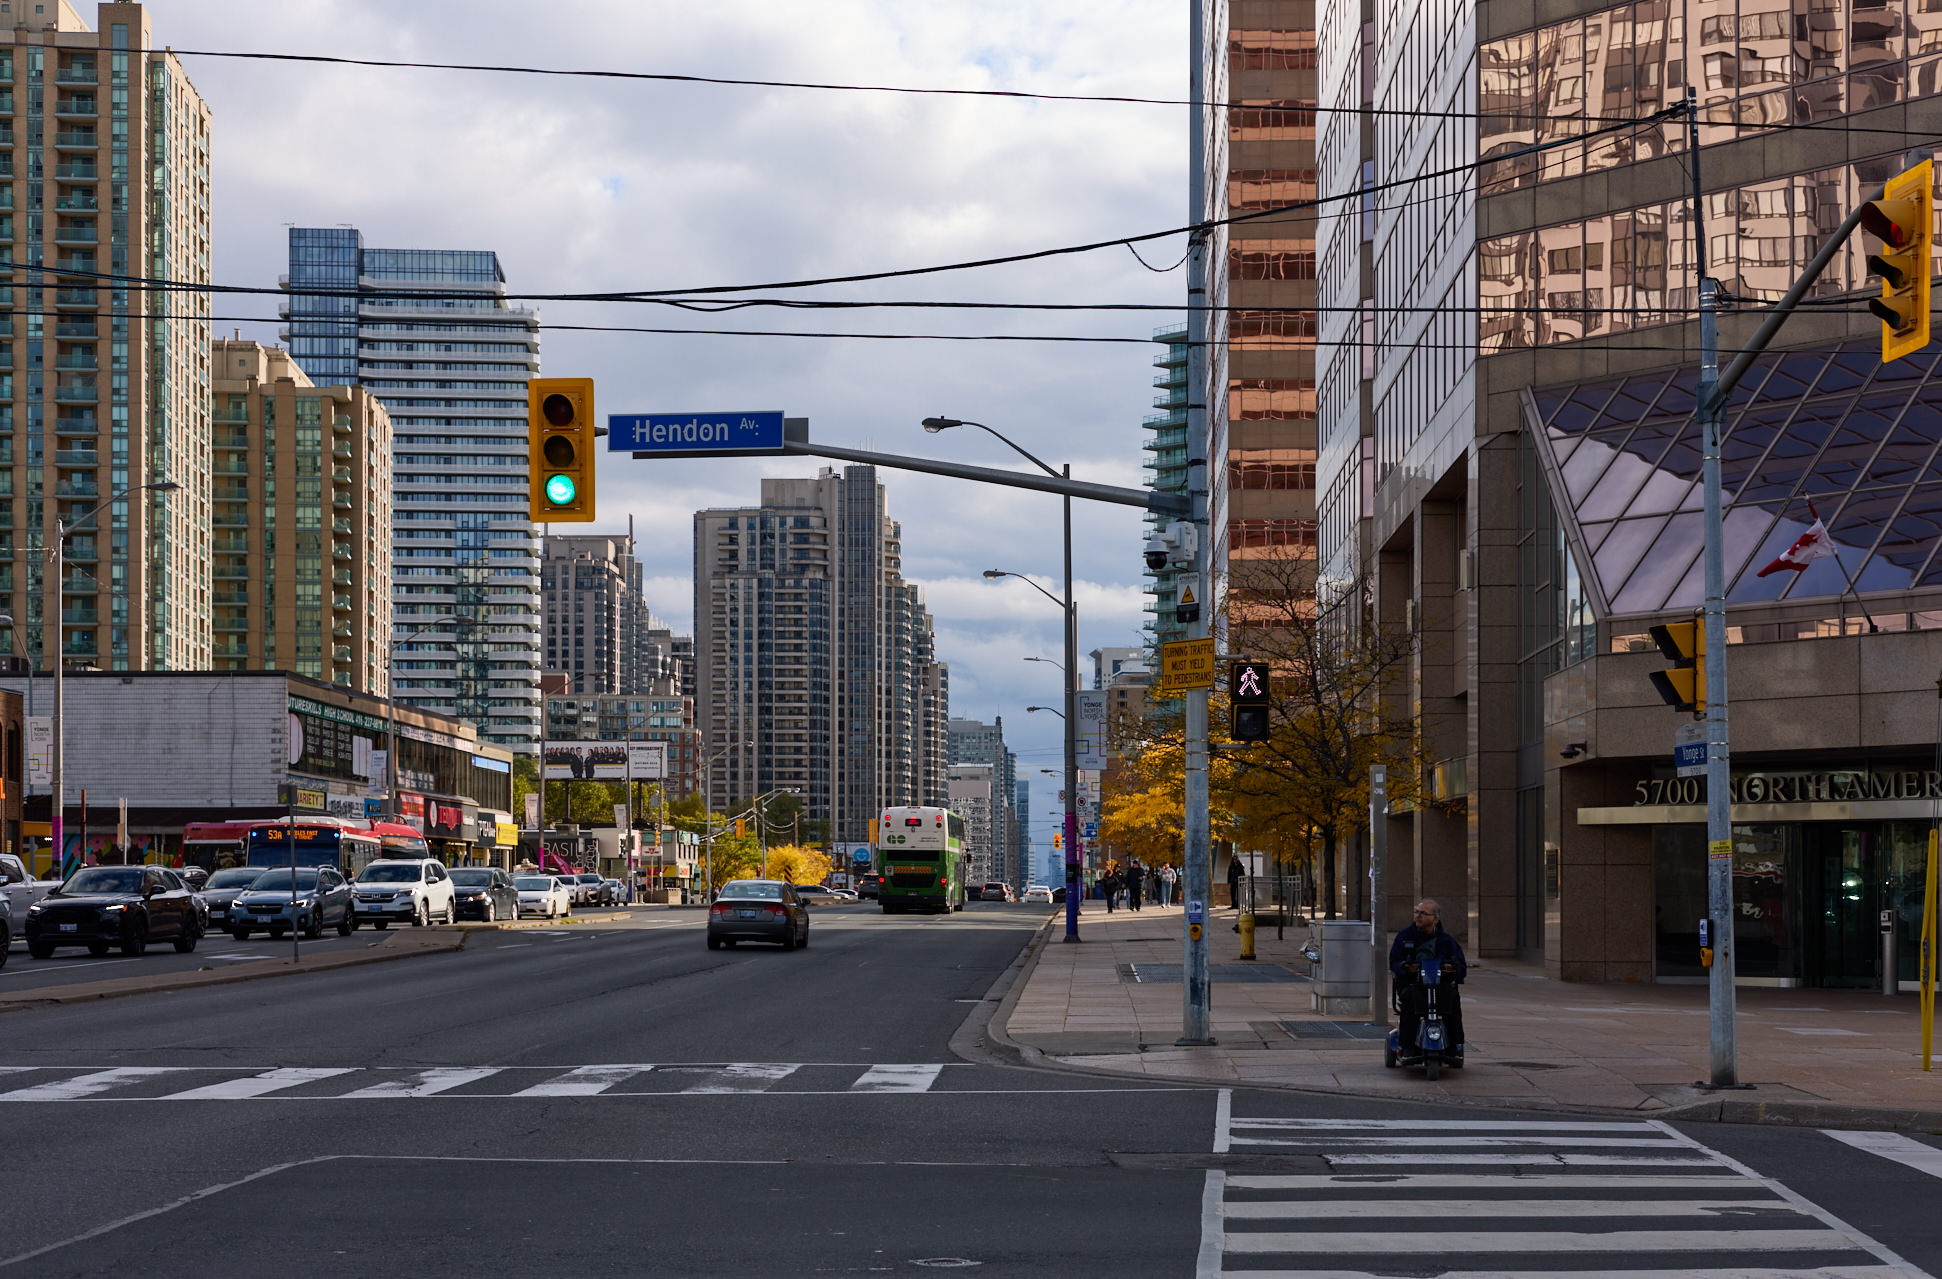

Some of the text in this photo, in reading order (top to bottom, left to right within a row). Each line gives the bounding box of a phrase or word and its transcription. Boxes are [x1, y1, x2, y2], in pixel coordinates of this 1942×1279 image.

[635, 418, 729, 443] Hendon
[1164, 643, 1212, 658] TURNING TRAFFIC
[1171, 658, 1205, 671] MUST YIELD
[1165, 671, 1212, 685] TO PEDESTRIANS
[288, 696, 322, 715] UTURESKILLS
[323, 705, 337, 719] HIGH
[337, 708, 355, 724] SCHOOL
[1682, 746, 1705, 763] Yonge St
[1634, 778, 1699, 805] 5700
[268, 829, 283, 840] 53A
[887, 834, 906, 844] GO
[543, 841, 579, 857] BASIL
